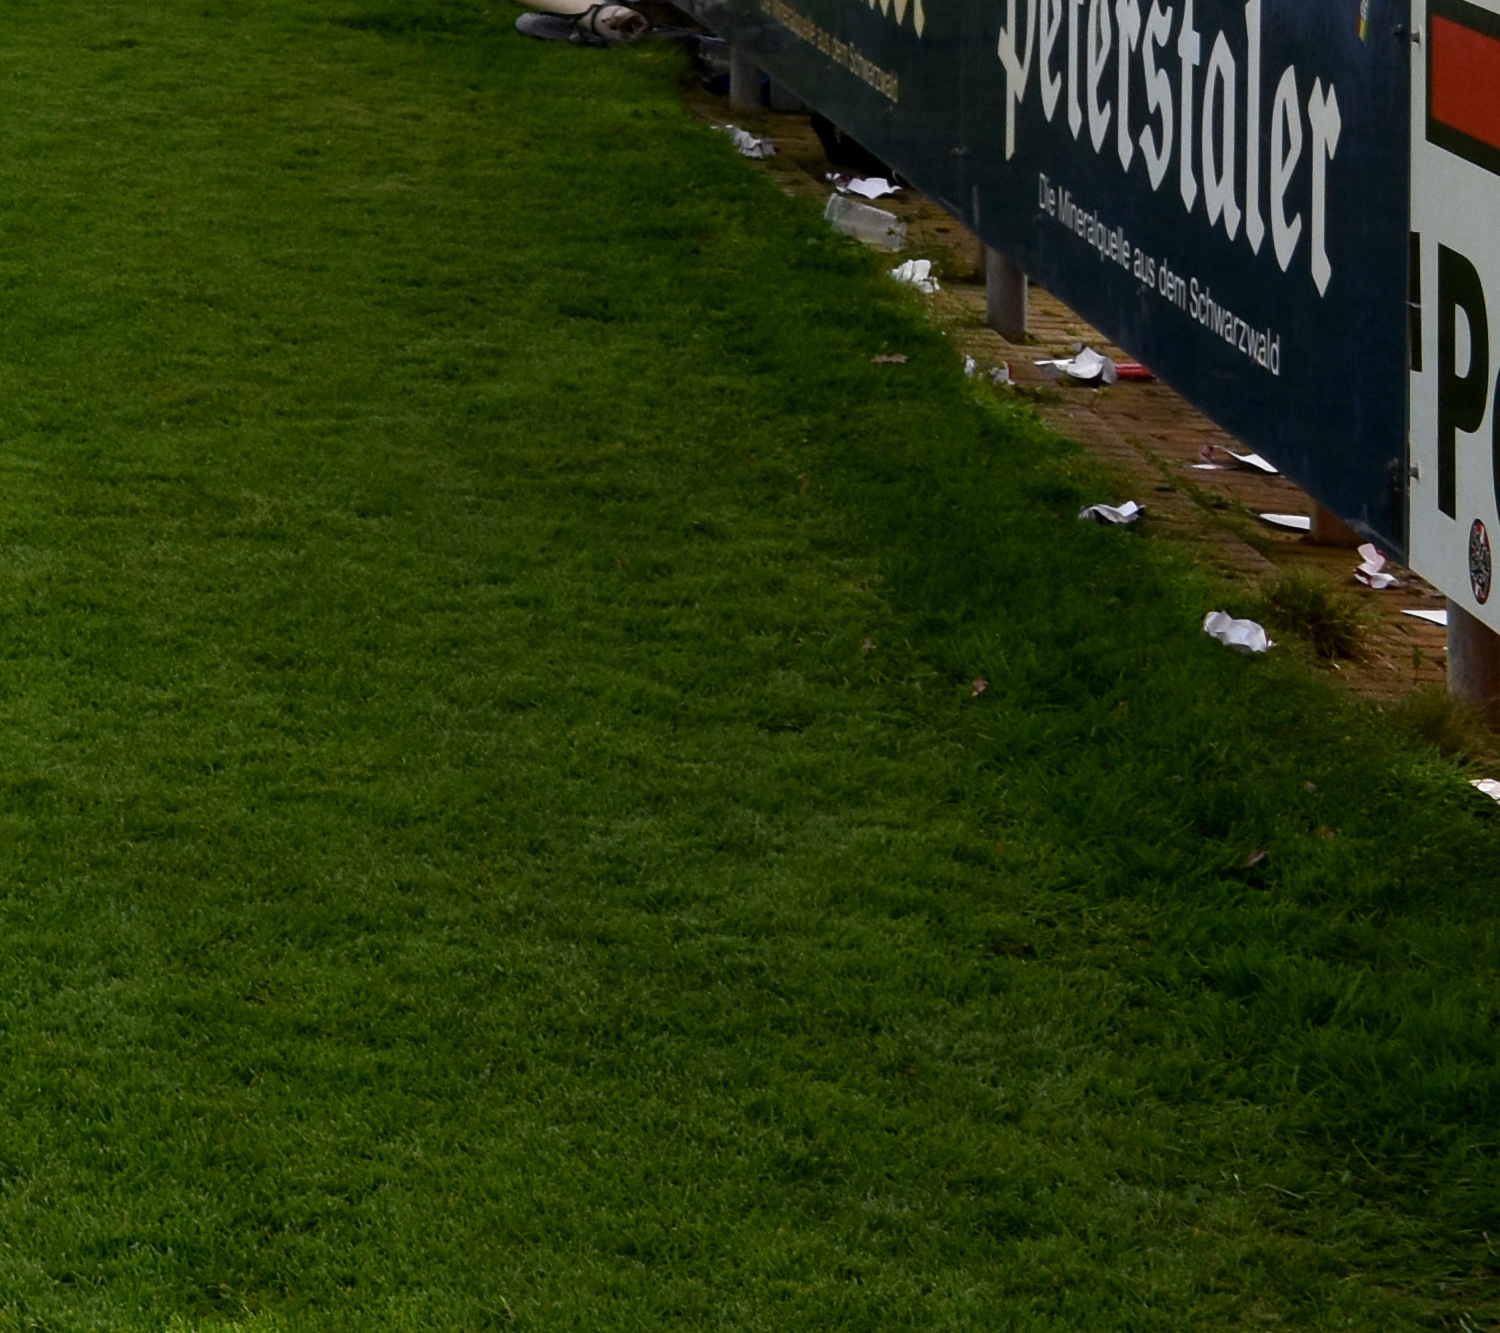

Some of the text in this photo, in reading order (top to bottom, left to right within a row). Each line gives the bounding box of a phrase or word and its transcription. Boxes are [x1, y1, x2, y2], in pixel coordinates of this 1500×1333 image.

[1038, 172, 1281, 376] Die Mineralquelle aus dem Schwarzwald
